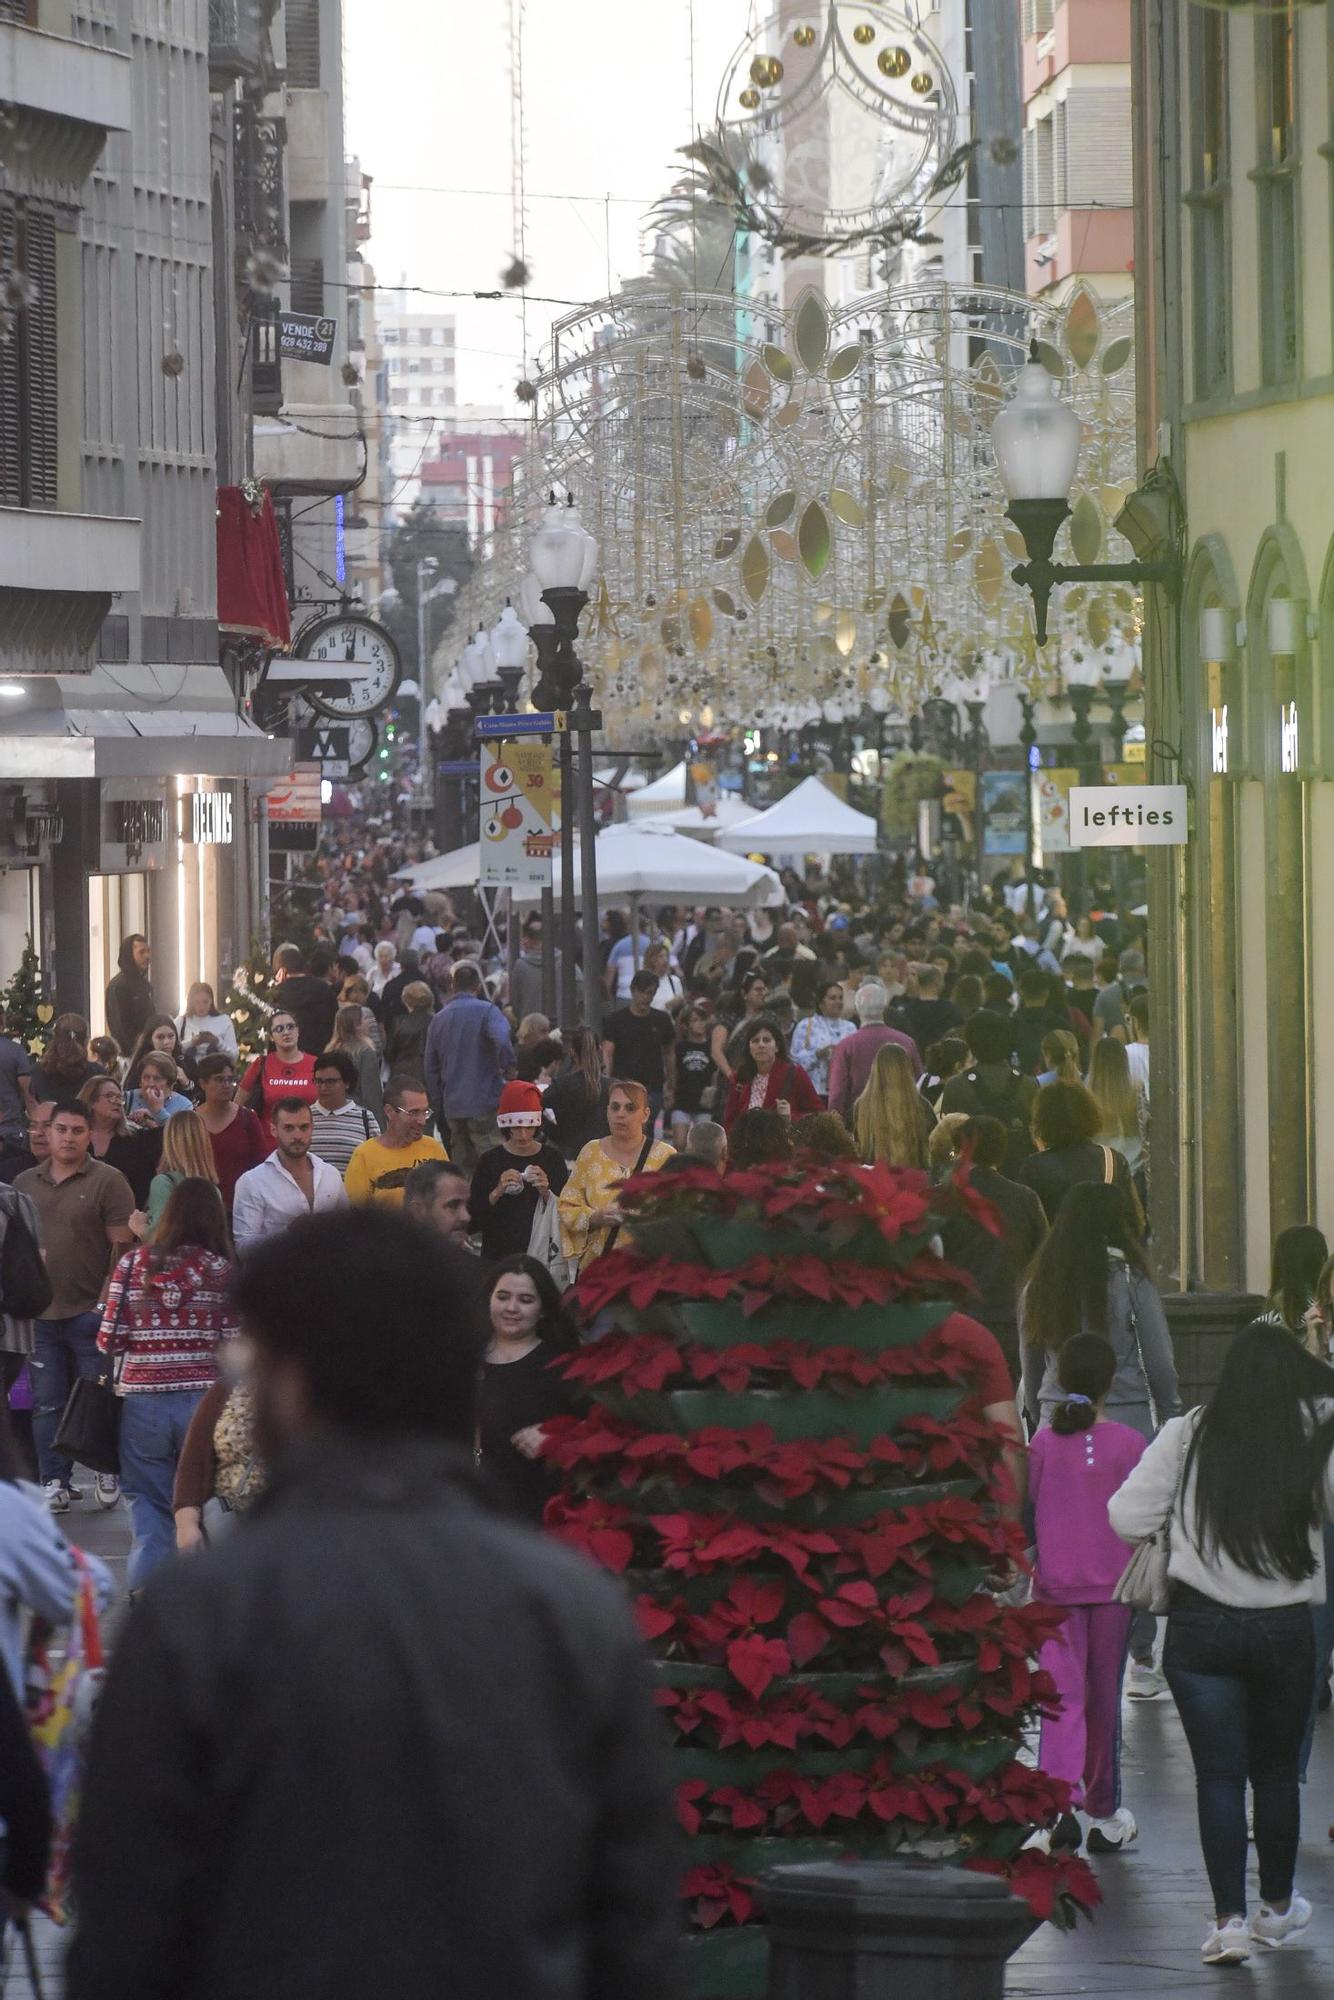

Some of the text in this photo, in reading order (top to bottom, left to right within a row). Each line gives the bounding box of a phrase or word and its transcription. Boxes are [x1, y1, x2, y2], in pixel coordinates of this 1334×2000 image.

[282, 322, 315, 338] VENDE
[320, 322, 333, 335] 21
[296, 339, 312, 350] 432
[329, 636, 336, 648] 11
[318, 647, 327, 659] 10
[372, 645, 380, 658] 2
[376, 659, 385, 673] 3
[372, 677, 380, 688] 4
[347, 693, 355, 705] 6
[362, 688, 370, 700] 5
[527, 774, 544, 788] 30
[1083, 804, 1173, 827] lefties
